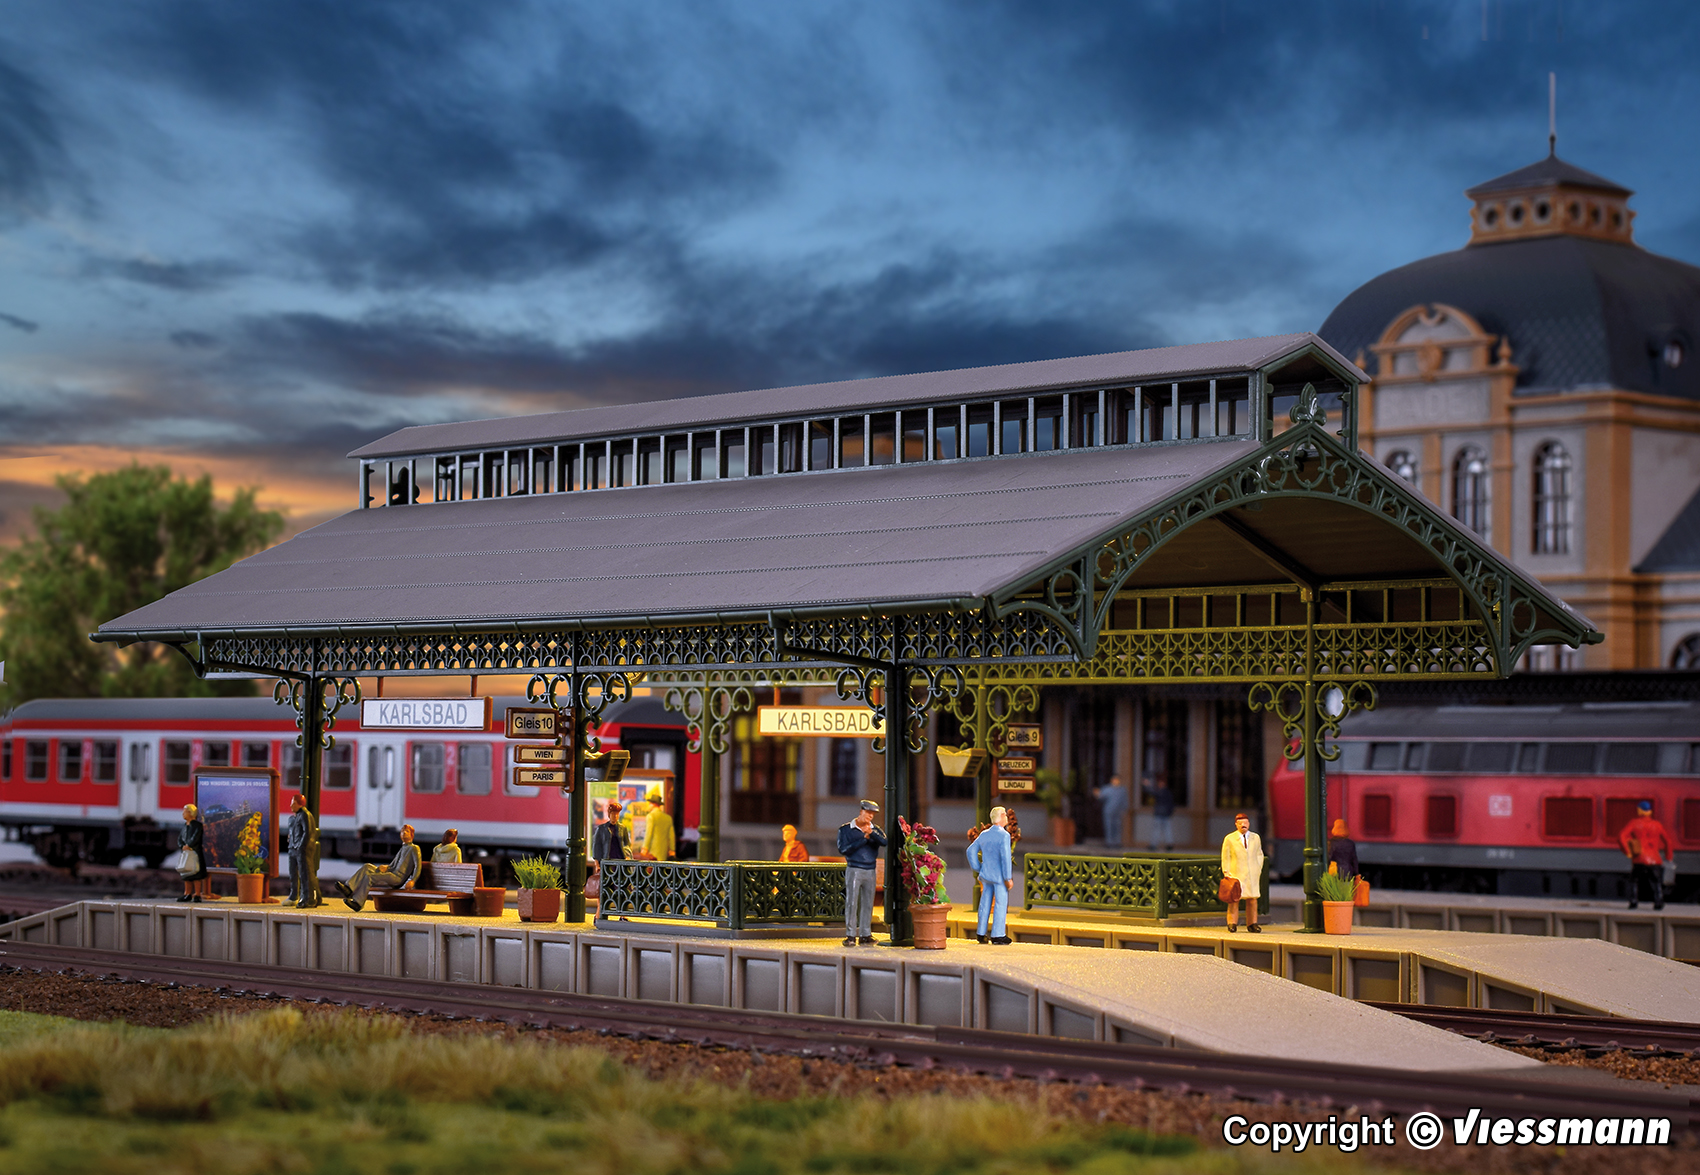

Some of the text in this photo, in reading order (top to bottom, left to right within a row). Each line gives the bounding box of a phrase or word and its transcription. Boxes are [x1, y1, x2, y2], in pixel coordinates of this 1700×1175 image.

[379, 703, 468, 724] KARLSBAD
[777, 712, 870, 731] KARLSBAD
[1007, 730, 1038, 742] Gleis 9
[532, 773, 554, 781] PARIS
[1003, 781, 1026, 789] LINDAU
